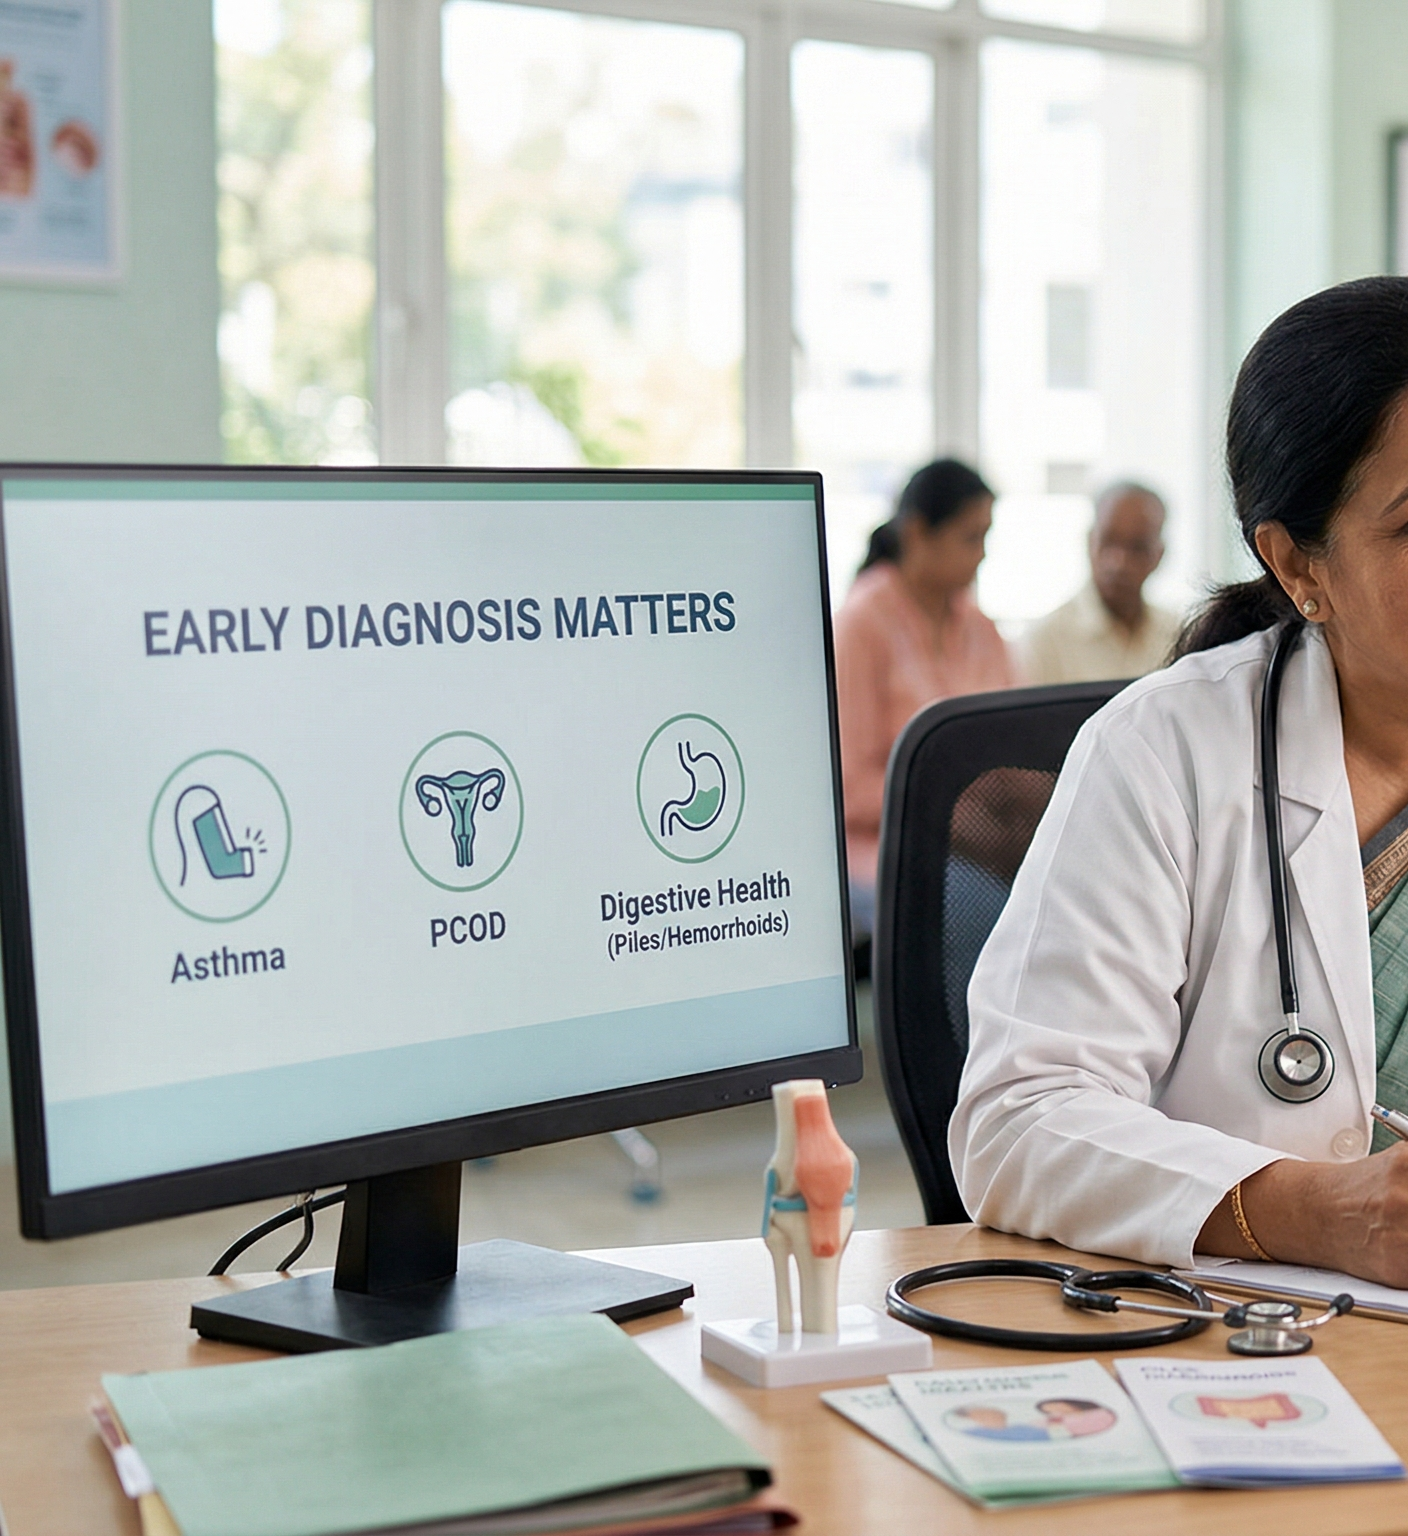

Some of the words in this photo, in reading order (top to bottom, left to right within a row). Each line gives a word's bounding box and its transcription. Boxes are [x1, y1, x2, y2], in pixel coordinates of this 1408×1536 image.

[144, 606, 290, 656] EARLY
[305, 598, 542, 650] DIAGNOSIS
[554, 591, 736, 639] MATTERS
[600, 884, 711, 925] Digestive
[718, 870, 790, 906] Health
[430, 911, 506, 947] PCOD
[608, 909, 789, 962] (Piles/Hemorrhoids)
[171, 946, 286, 983] Asthma
